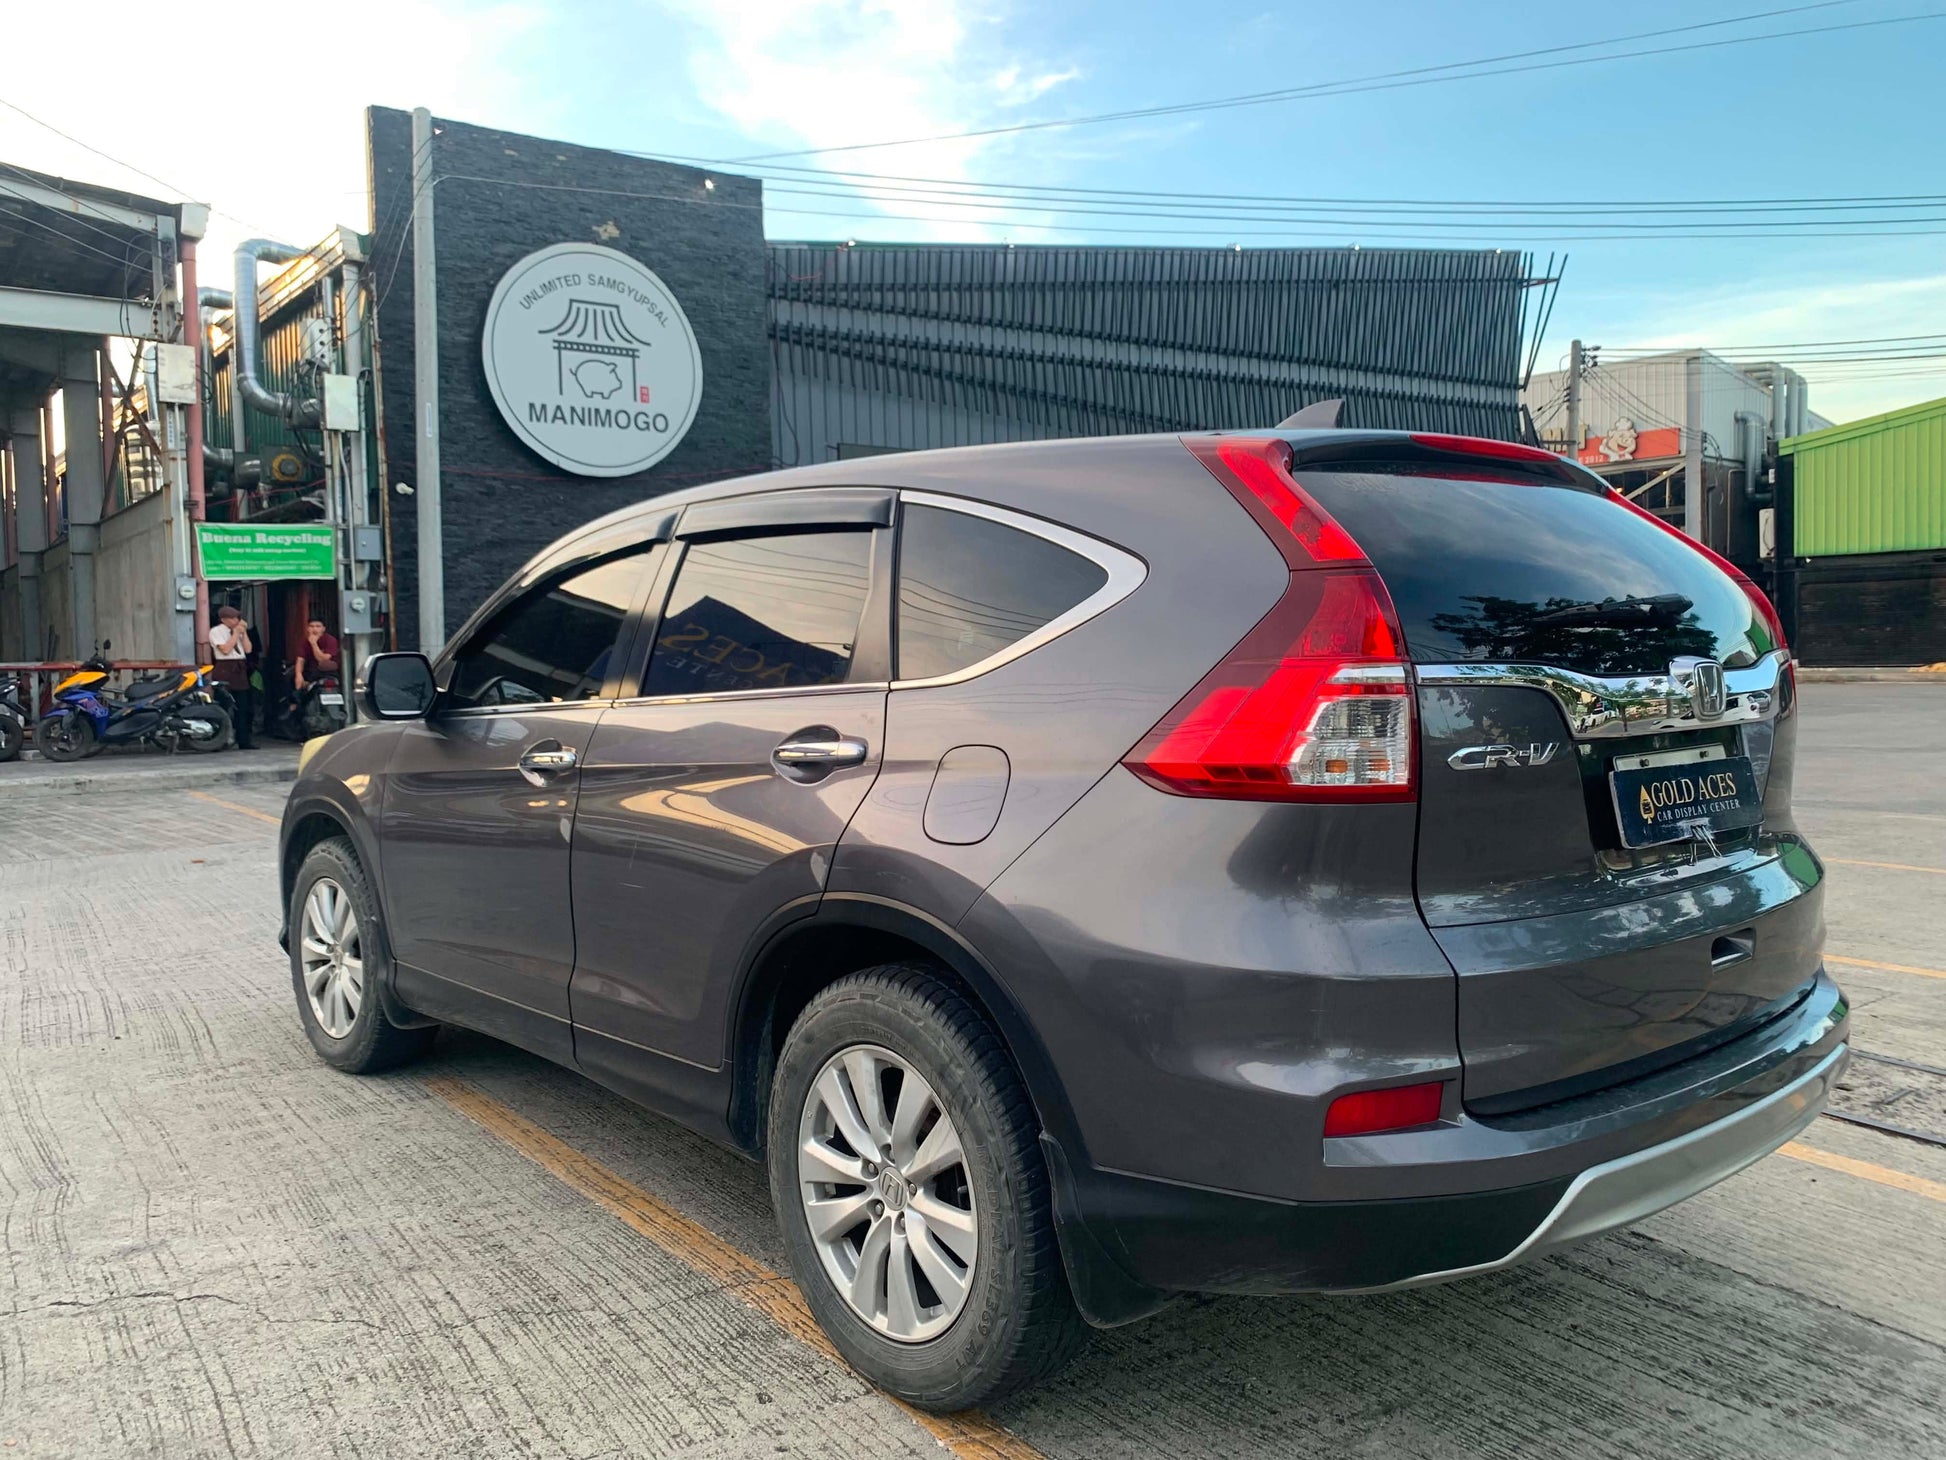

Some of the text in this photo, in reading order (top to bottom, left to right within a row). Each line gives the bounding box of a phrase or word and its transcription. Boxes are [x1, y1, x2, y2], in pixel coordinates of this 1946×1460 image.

[519, 273, 670, 328] UNLIMITED SAMGYUPSAL
[528, 402, 670, 433] MANIMOGO
[202, 532, 332, 546] Buena Recycling
[1447, 742, 1560, 771] CR-V
[1651, 772, 1736, 807] GOLD ACES
[1656, 798, 1741, 822] CAR DISPLAY CENTER
